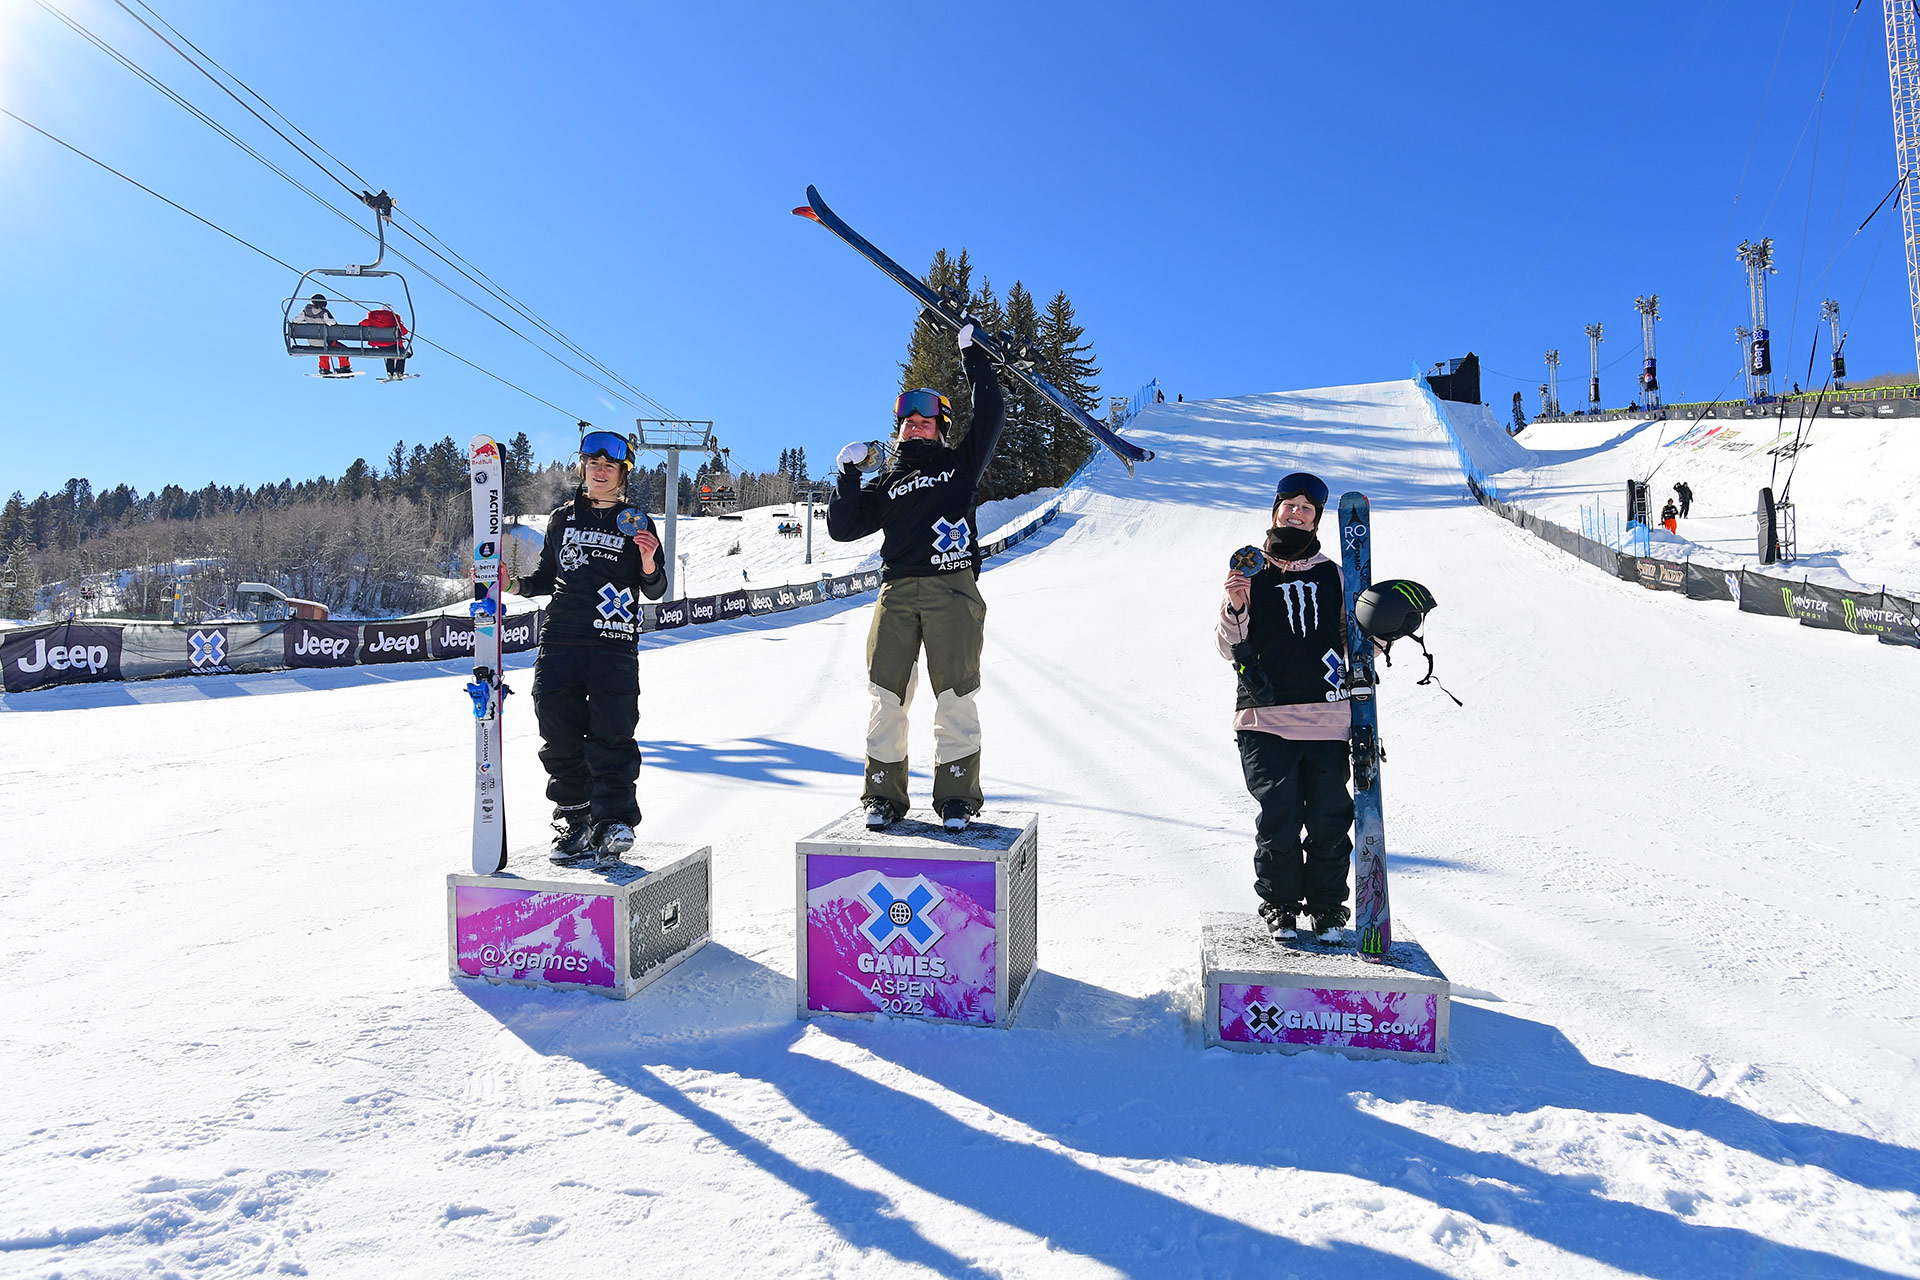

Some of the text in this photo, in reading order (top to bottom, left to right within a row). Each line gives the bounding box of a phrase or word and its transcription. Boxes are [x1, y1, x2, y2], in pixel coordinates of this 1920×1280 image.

[1754, 344, 1765, 369] Jeep
[888, 471, 948, 500] verizon
[489, 490, 498, 534] FACTION
[562, 527, 625, 549] PACIFICO
[591, 550, 618, 562] CLARA
[930, 550, 972, 565] GAMES
[938, 560, 972, 571] ASPEN
[691, 602, 714, 619] Jeep
[723, 596, 746, 612] Jeep
[751, 593, 774, 611] Jeep
[660, 609, 683, 624] Jeep
[1856, 606, 1904, 625] MONSTER
[593, 619, 634, 634] GAMES
[295, 629, 350, 659] Jeep
[369, 631, 419, 654] Jeep
[440, 625, 475, 650] Jeep
[600, 631, 633, 641] ASPEN
[18, 639, 108, 674] Jeep
[191, 664, 232, 674] GAMES
[1325, 689, 1350, 702] GAM
[480, 945, 589, 973] @xgames
[858, 953, 946, 978] GAMES
[870, 979, 935, 997] ASPEN
[881, 999, 924, 1015] 2022
